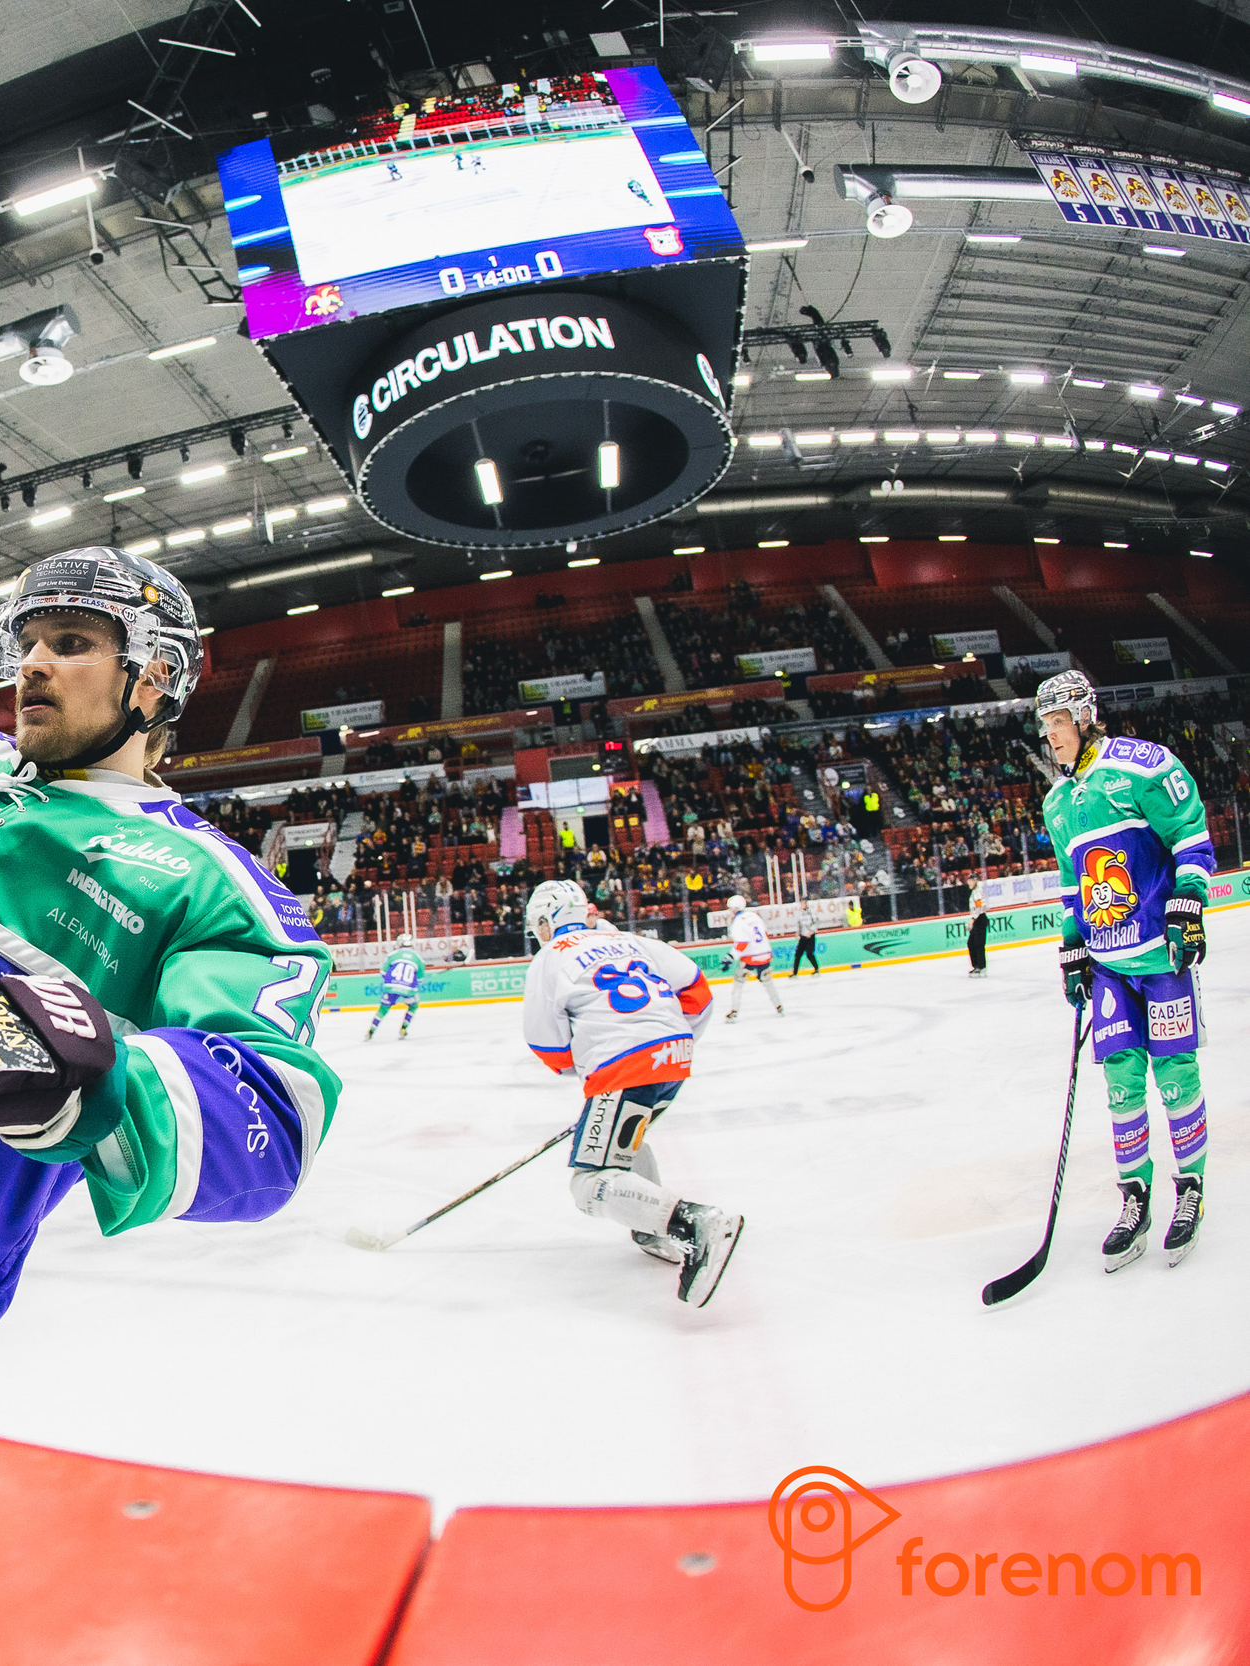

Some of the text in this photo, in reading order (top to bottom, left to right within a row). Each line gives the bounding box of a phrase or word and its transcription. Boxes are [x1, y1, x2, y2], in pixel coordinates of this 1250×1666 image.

[1072, 203, 1088, 222] 5
[1108, 206, 1127, 225] 15
[1145, 211, 1161, 230] 17
[1181, 215, 1196, 234] 17
[1211, 220, 1231, 239] 23
[439, 249, 564, 296] 0 14:00 0
[370, 316, 616, 415] CIRCULATION
[35, 569, 89, 577] TECHNOLOGY
[36, 561, 90, 571] CREATIVE
[1161, 768, 1190, 807] 16
[138, 875, 160, 892] OLUT
[66, 867, 145, 935] MEDIATEKO
[280, 903, 306, 915] TOYO
[278, 913, 313, 928] KAIVOKS
[46, 907, 119, 975] ALEXANDRIA
[390, 963, 416, 984] 40
[471, 978, 525, 992] ROTO
[1149, 999, 1191, 1020] CABLE
[1150, 1018, 1190, 1037] CREW
